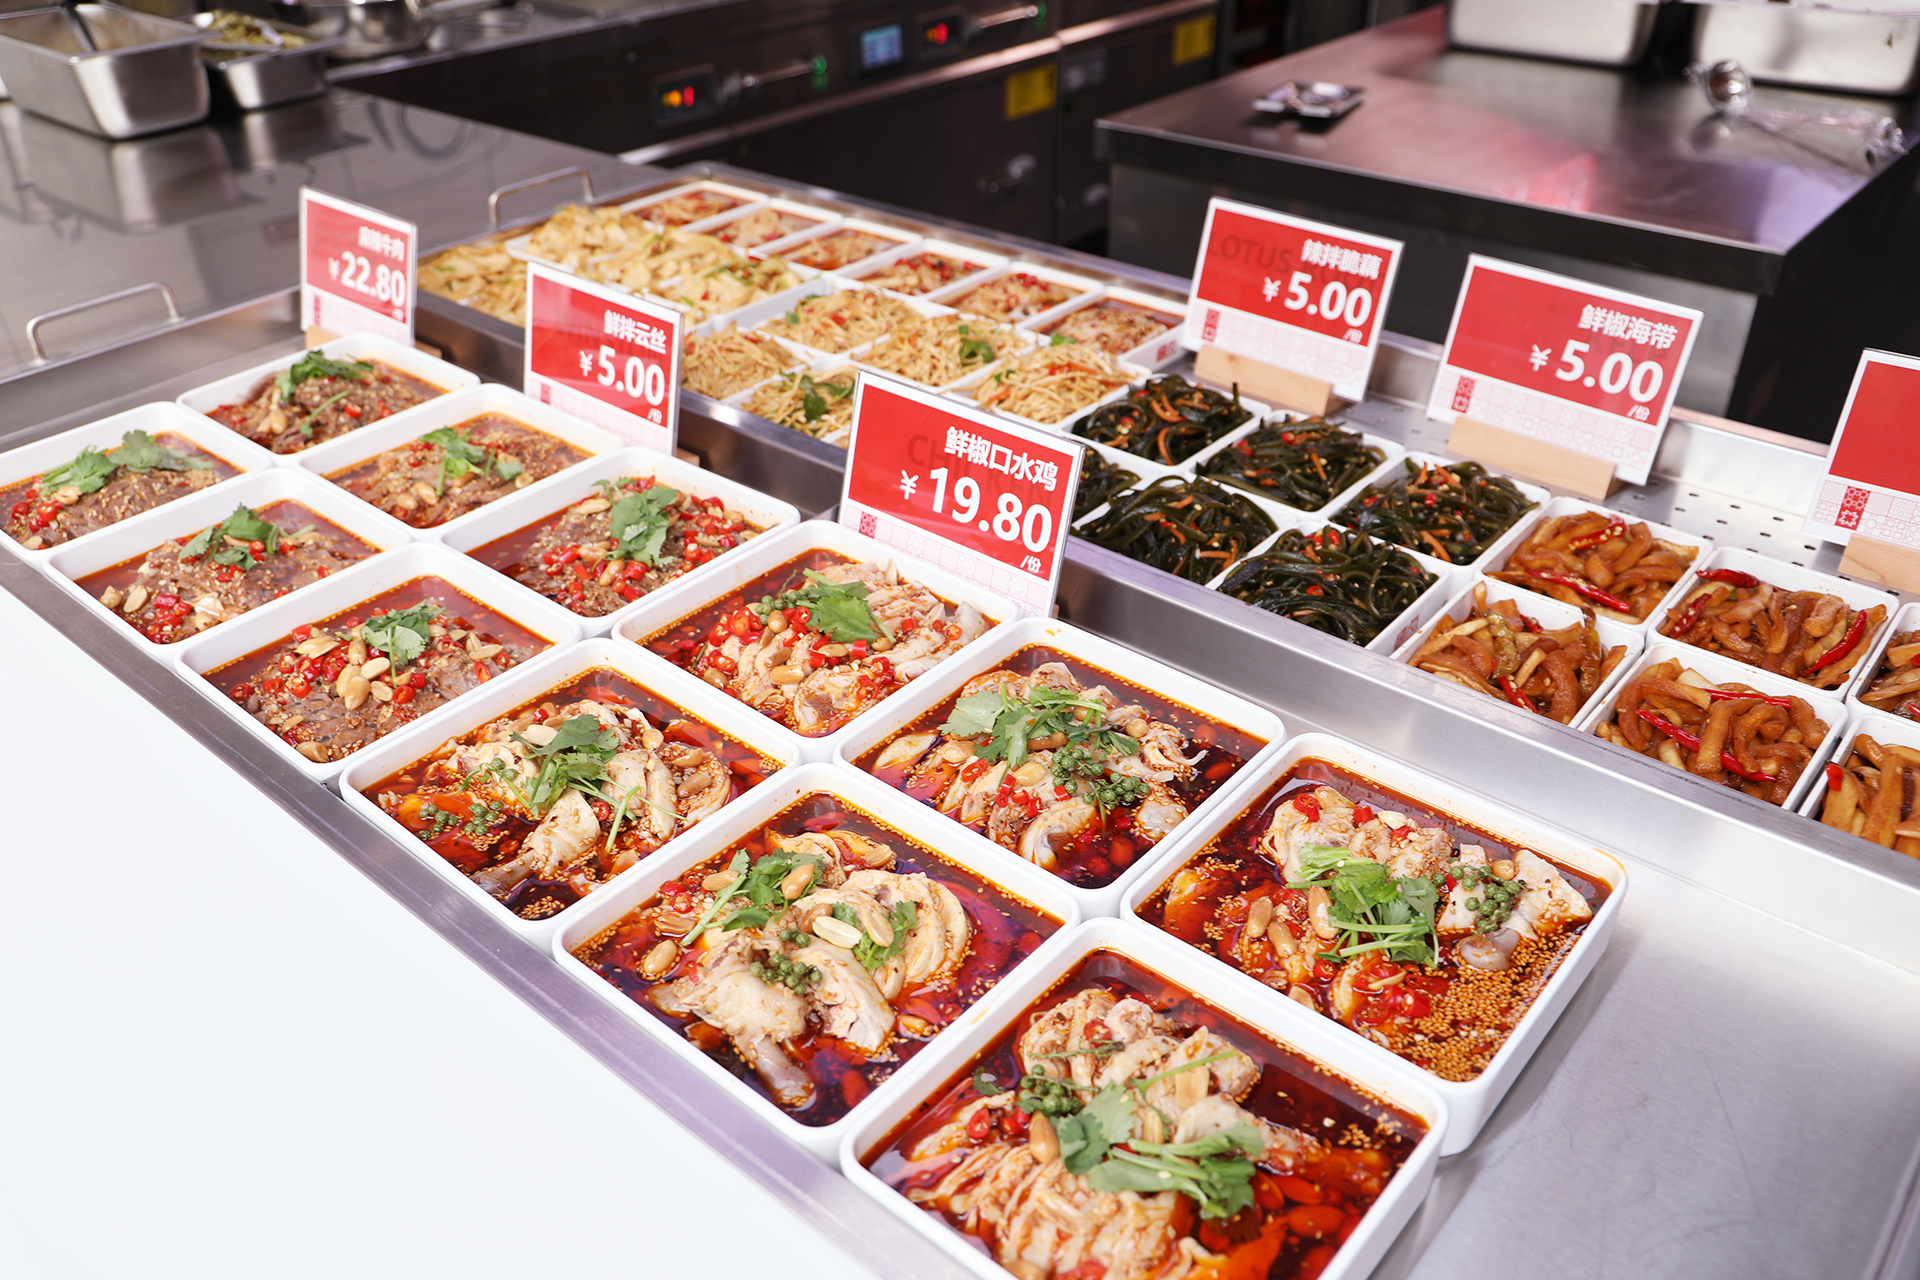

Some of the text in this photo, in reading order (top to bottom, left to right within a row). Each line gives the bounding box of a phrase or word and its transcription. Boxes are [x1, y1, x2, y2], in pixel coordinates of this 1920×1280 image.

[1302, 239, 1382, 279] 辣拌脆藕
[1285, 271, 1372, 326] 5.00
[604, 310, 666, 354] 鲜拌云丝
[1579, 304, 1678, 348] 鲜椒海带
[598, 345, 665, 405] 5.00
[1556, 340, 1663, 402] 5.00
[1627, 405, 1650, 422] /份
[945, 426, 1058, 491] 鲜椒口水鸡
[930, 468, 1052, 552] 19.80
[1020, 555, 1042, 574] /份
